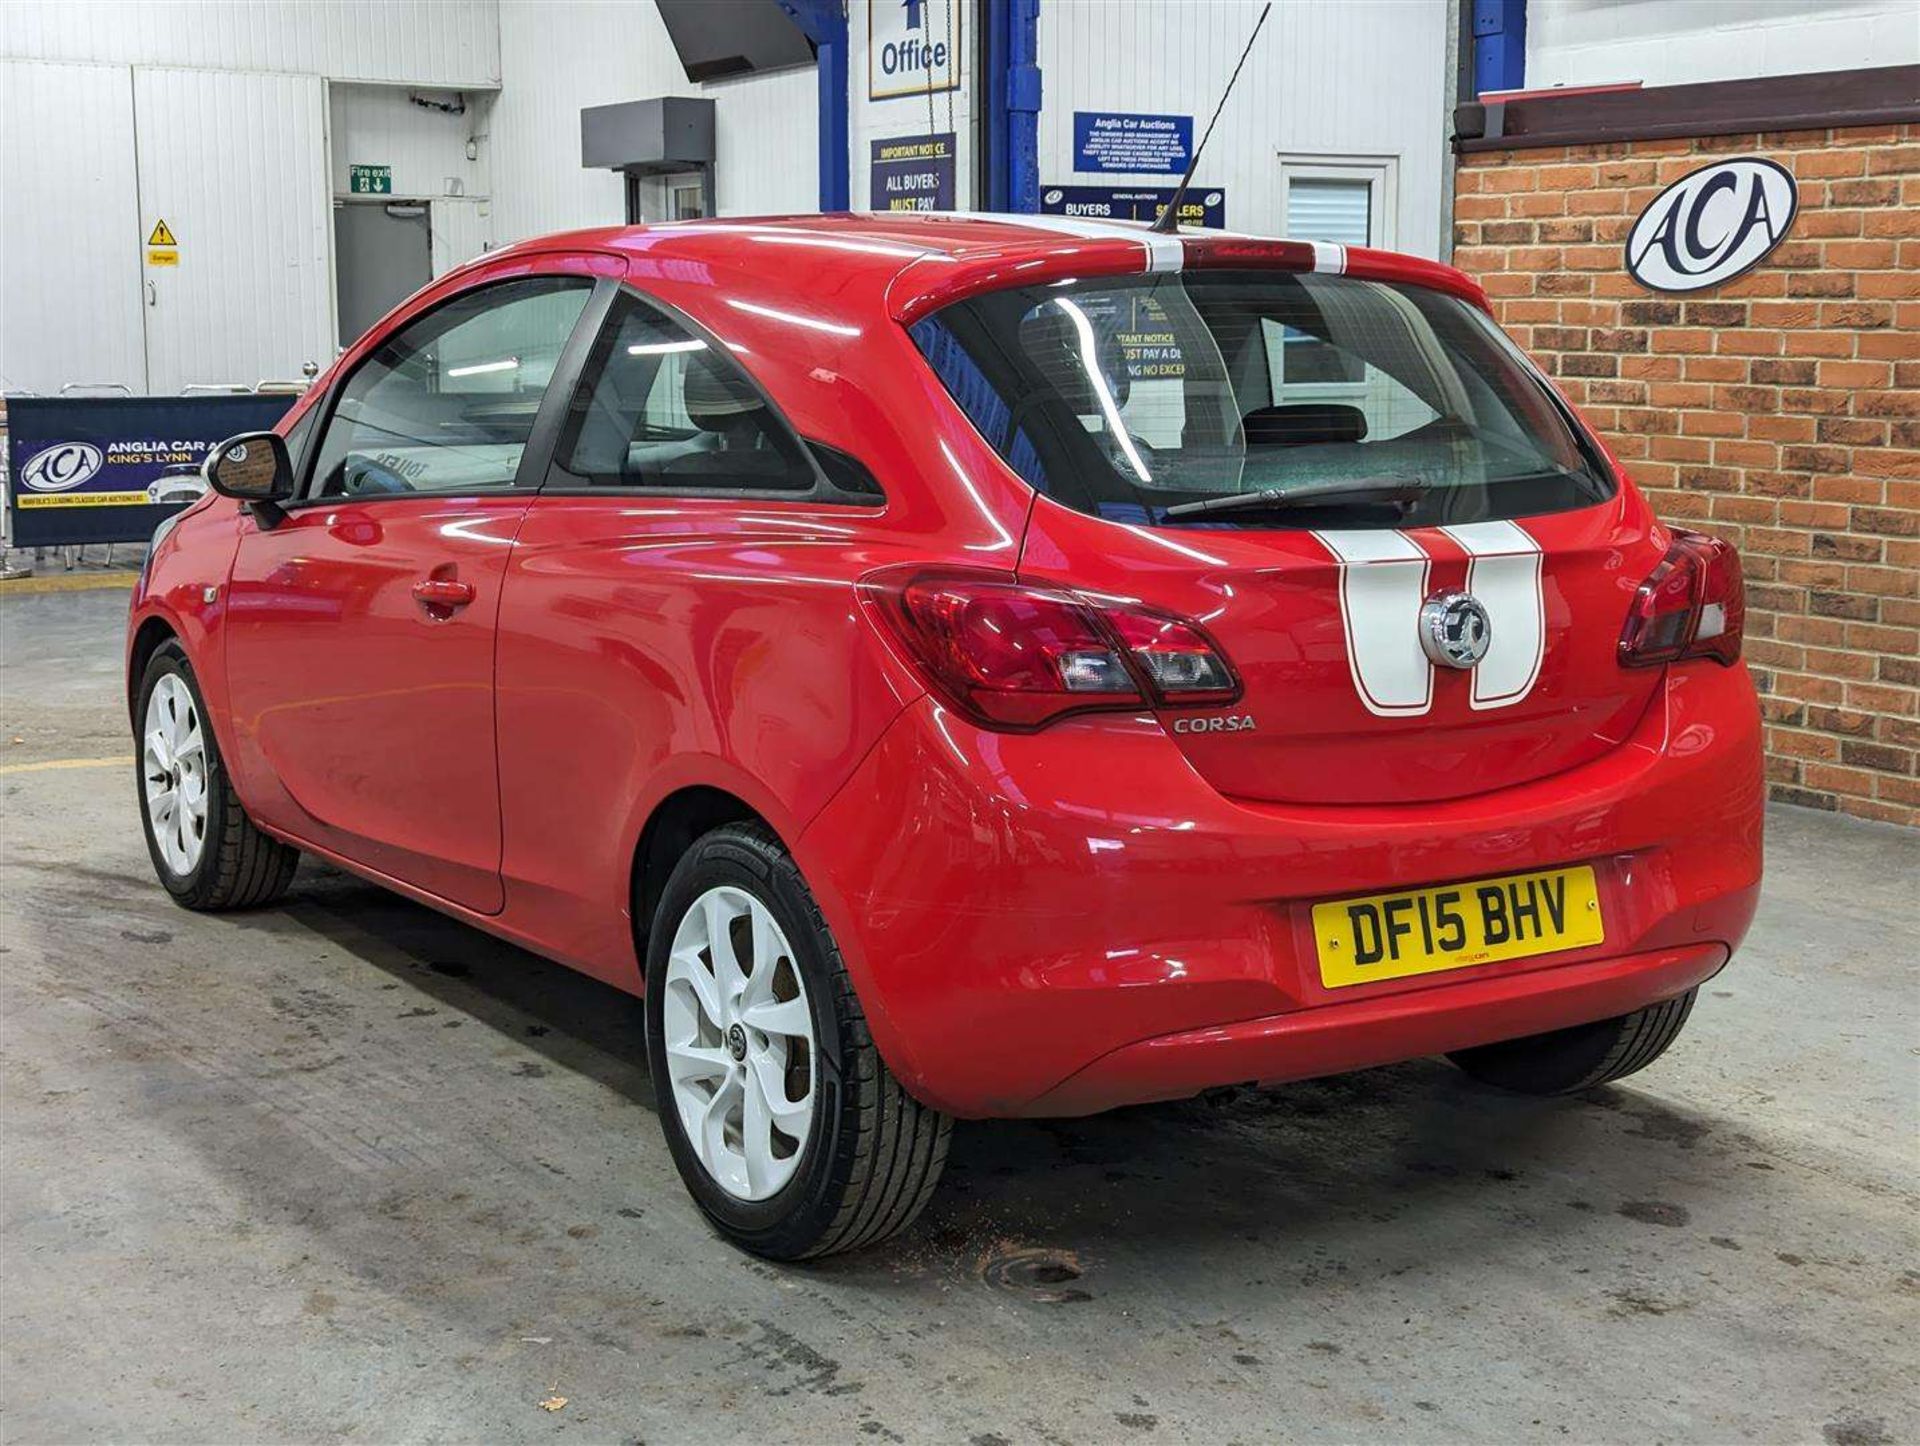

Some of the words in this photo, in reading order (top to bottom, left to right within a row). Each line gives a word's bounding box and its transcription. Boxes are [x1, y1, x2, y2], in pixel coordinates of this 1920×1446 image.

[882, 38, 946, 75] Office
[1095, 118, 1122, 130] Anglia
[1123, 119, 1138, 129] Car
[1139, 120, 1176, 130] Auctions
[881, 144, 919, 159] IMPORTANT
[919, 142, 945, 155] NOTCE
[351, 166, 371, 178] Fire
[886, 175, 903, 191] ALL
[903, 172, 940, 191] BUYERS
[890, 198, 916, 212] MUST
[918, 196, 936, 211] PAY
[1065, 203, 1111, 216] BUYERS
[1632, 170, 1777, 276] ACA
[1117, 333, 1142, 343] TANT
[1144, 333, 1175, 342] NOTICE
[1123, 348, 1141, 359] UST
[1142, 348, 1159, 359] PAY
[1161, 348, 1169, 359] A
[1142, 364, 1158, 375] NO
[107, 441, 169, 453] ANGLIA
[171, 441, 205, 452] CAR
[107, 452, 153, 464] KING'S
[155, 452, 193, 463] LYNN
[27, 447, 94, 485] ACA
[1173, 715, 1256, 733] CORSA
[1347, 891, 1467, 966] DF15
[1476, 875, 1565, 946] BHV
